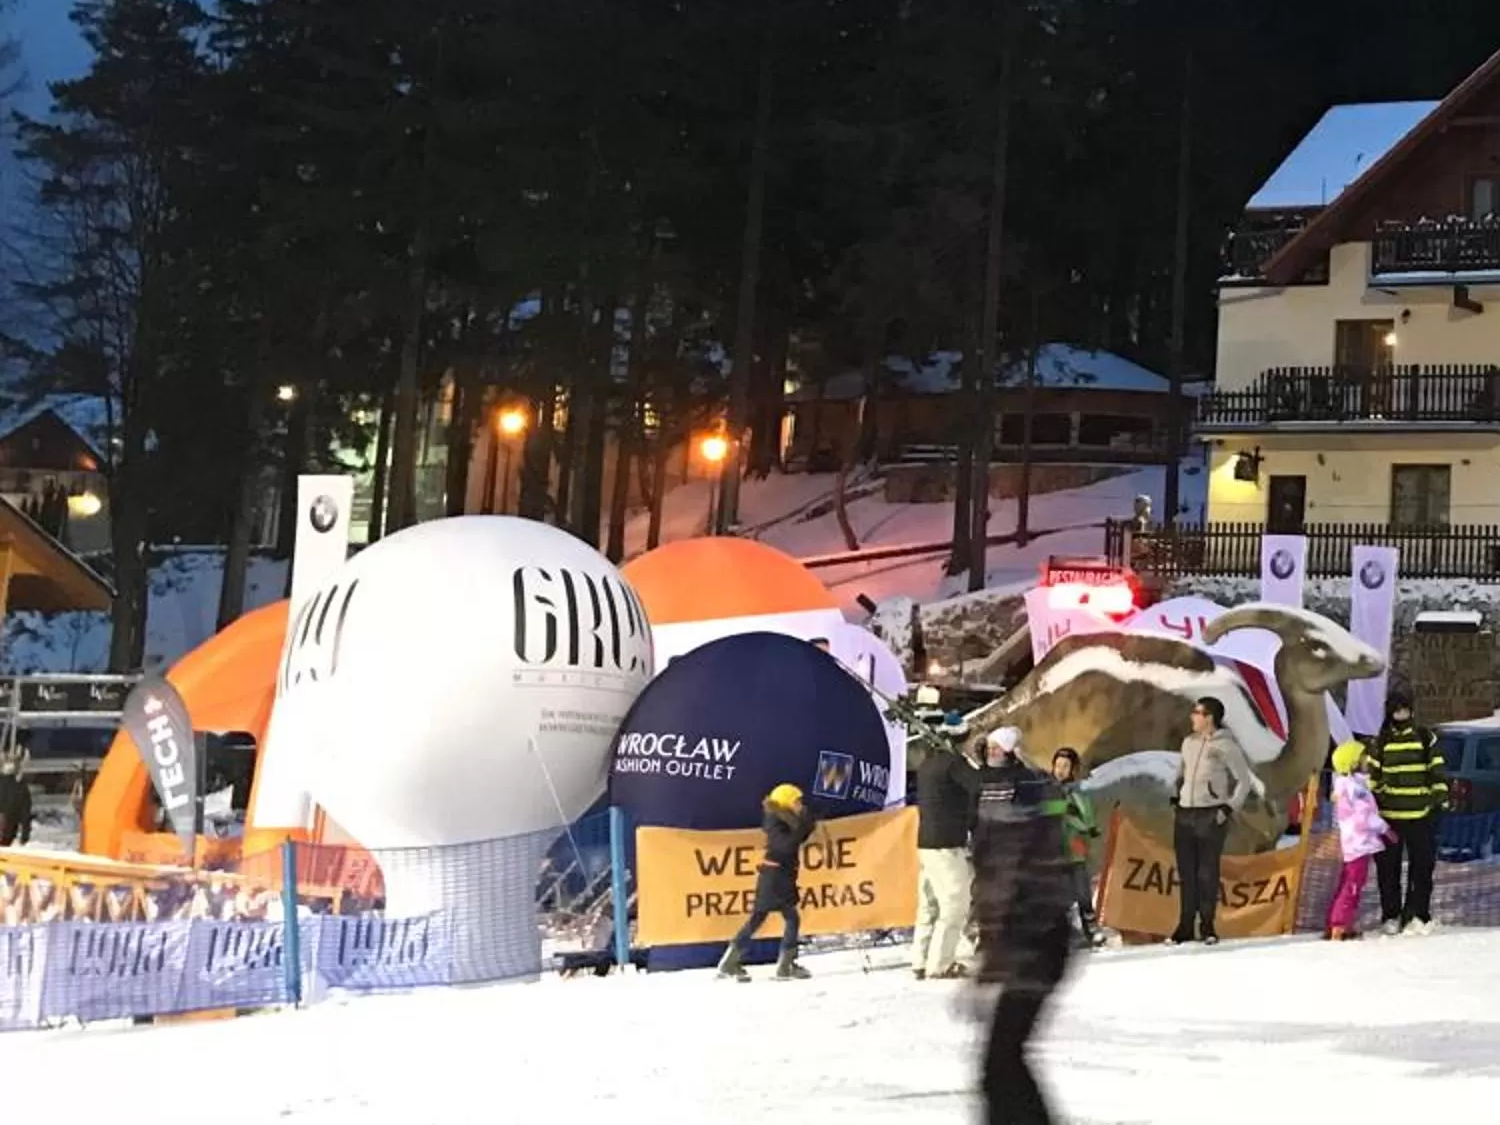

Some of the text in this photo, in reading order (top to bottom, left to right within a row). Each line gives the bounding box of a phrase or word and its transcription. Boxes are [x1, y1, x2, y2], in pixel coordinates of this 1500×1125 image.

[615, 758, 736, 780] ASHION OUTLET
[694, 837, 858, 876] WECIE
[686, 889, 757, 918] PRZE
